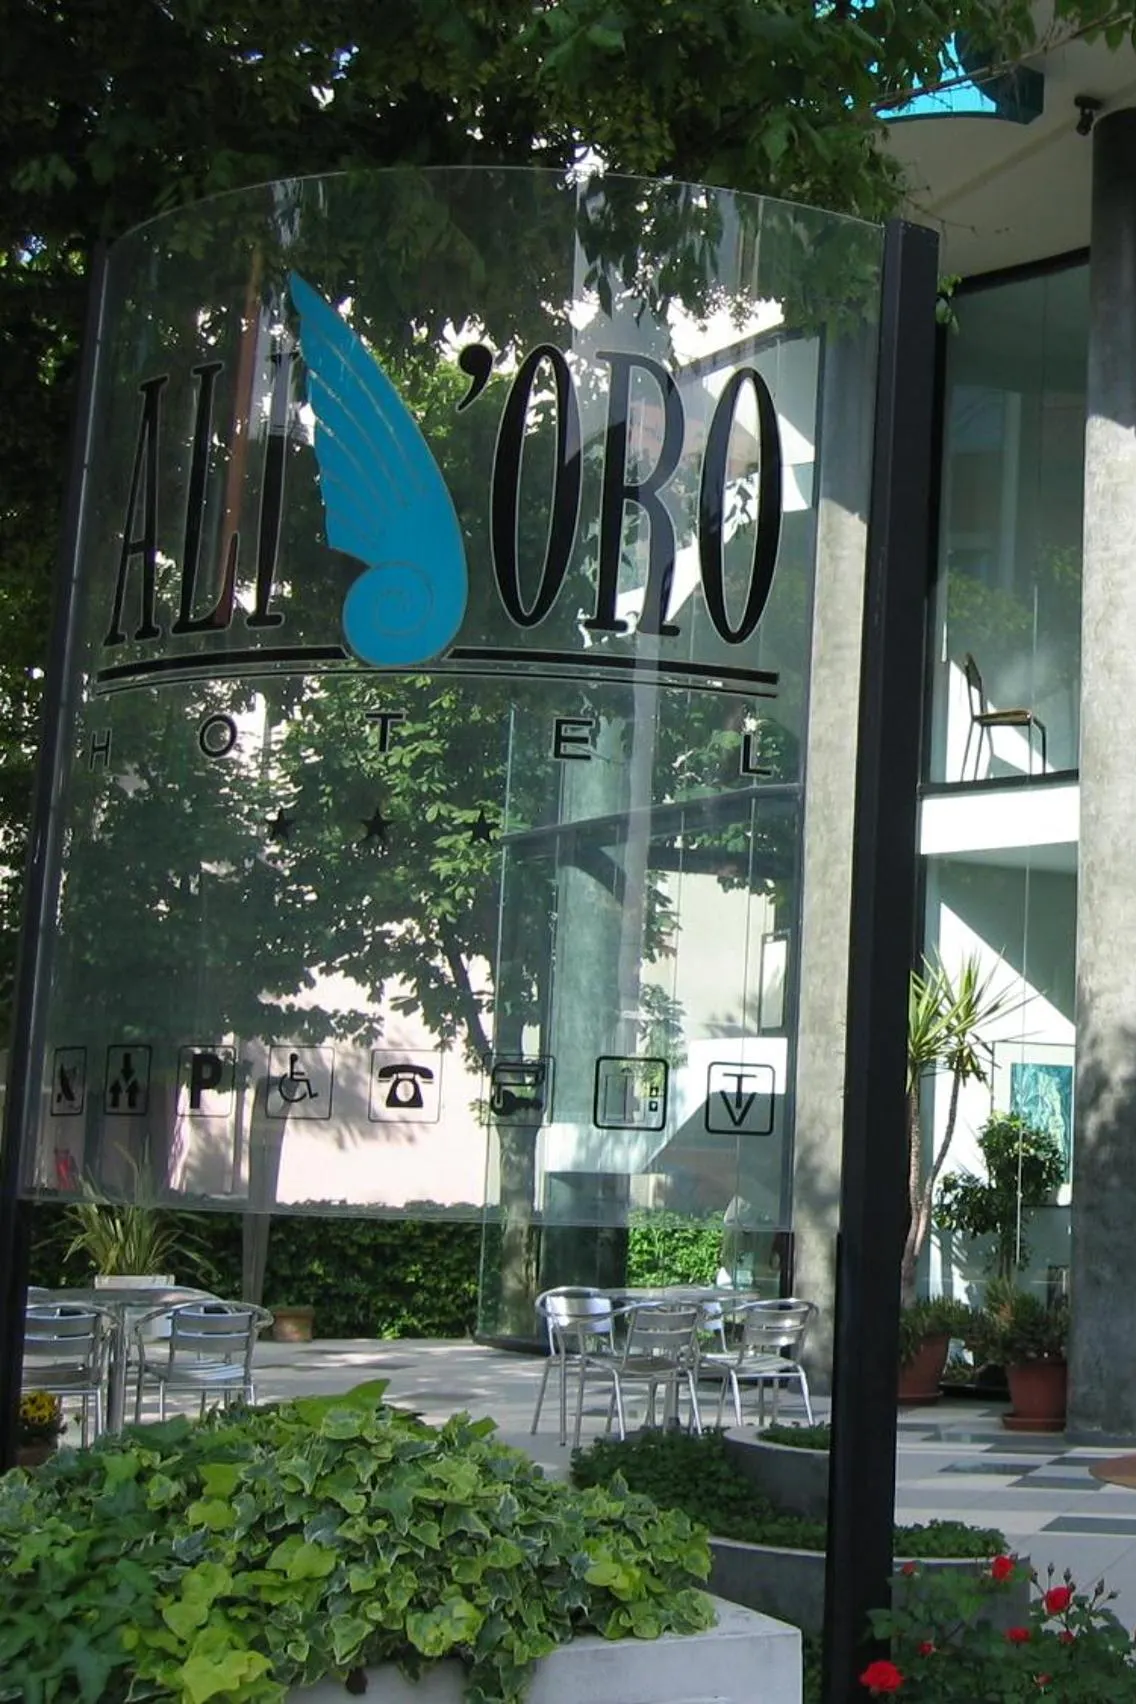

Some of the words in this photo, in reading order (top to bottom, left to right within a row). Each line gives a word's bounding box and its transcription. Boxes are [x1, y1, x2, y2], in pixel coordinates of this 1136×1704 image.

[103, 351, 300, 646] ALI
[88, 711, 772, 777] HOTEL
[190, 1053, 222, 1109] P
